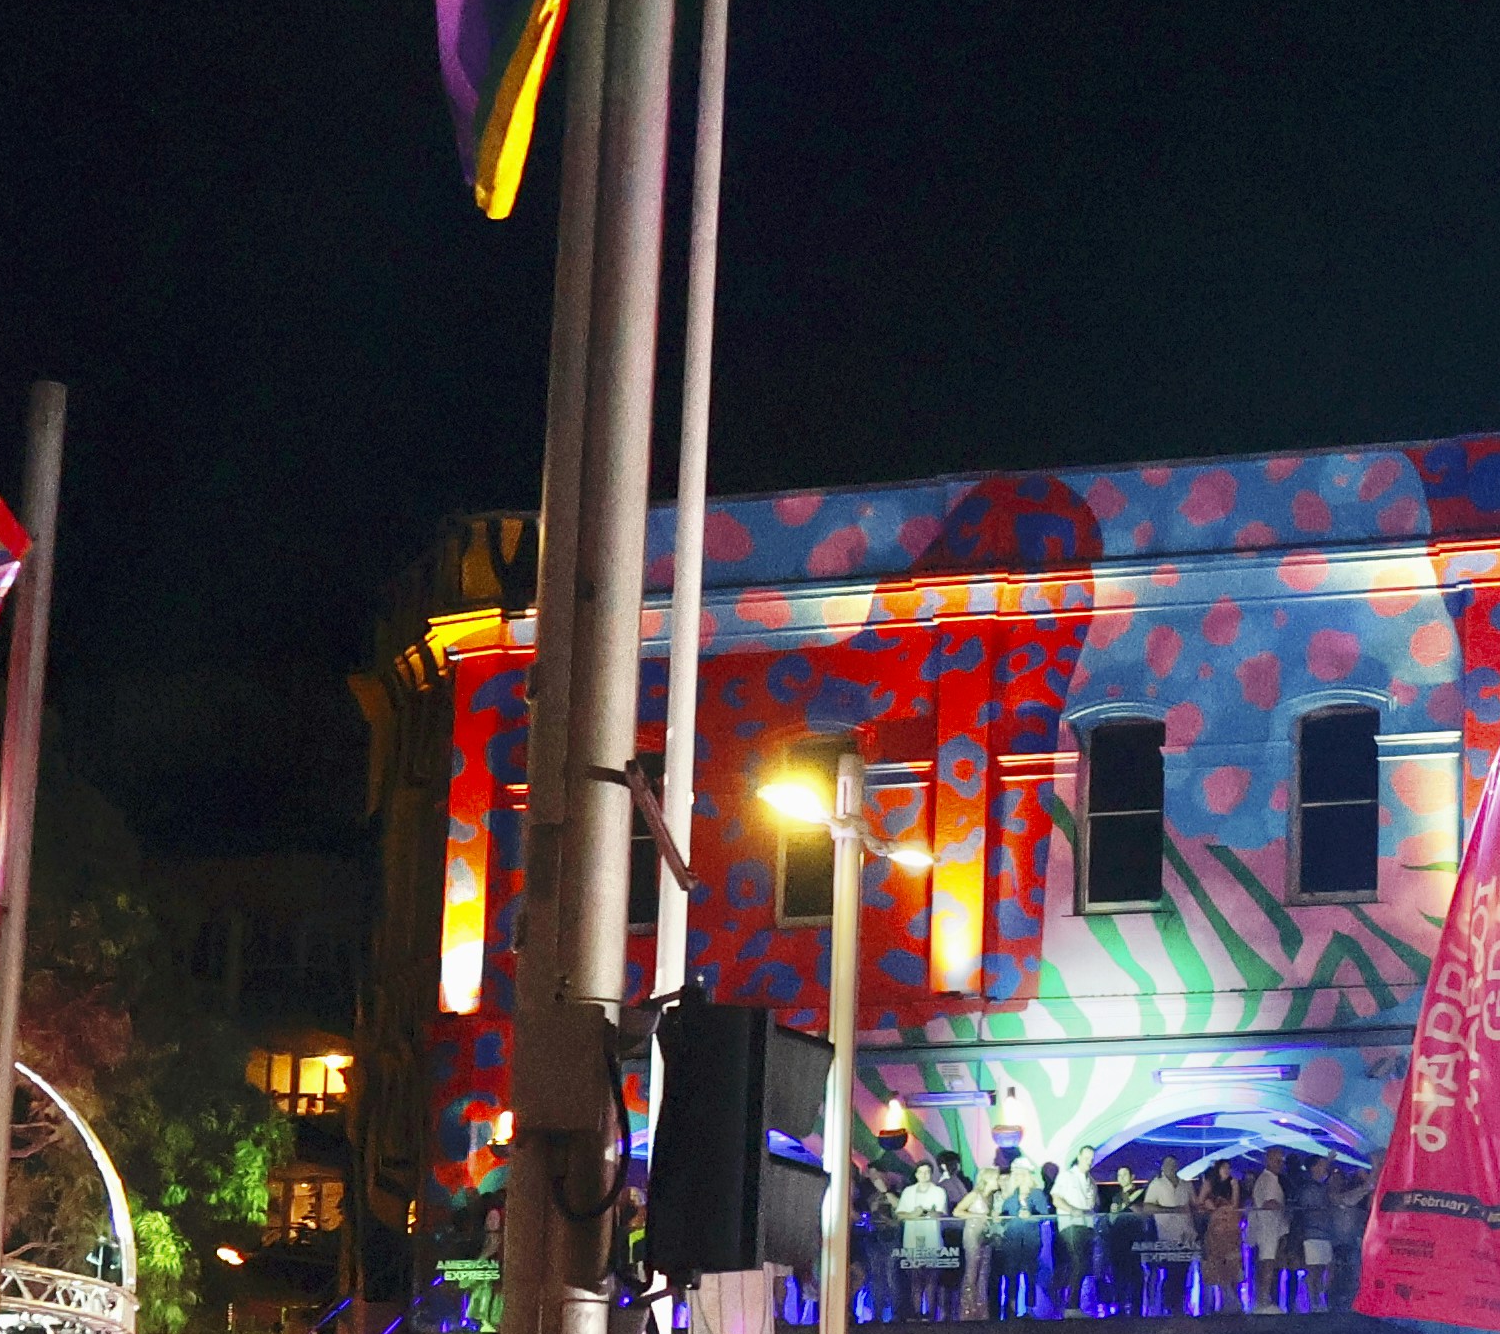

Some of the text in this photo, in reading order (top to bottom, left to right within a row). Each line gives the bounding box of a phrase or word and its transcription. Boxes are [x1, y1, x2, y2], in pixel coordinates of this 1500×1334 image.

[1410, 943, 1470, 1153] HAPP
[1413, 1192, 1472, 1215] February
[444, 1270, 501, 1280] EXPRESS
